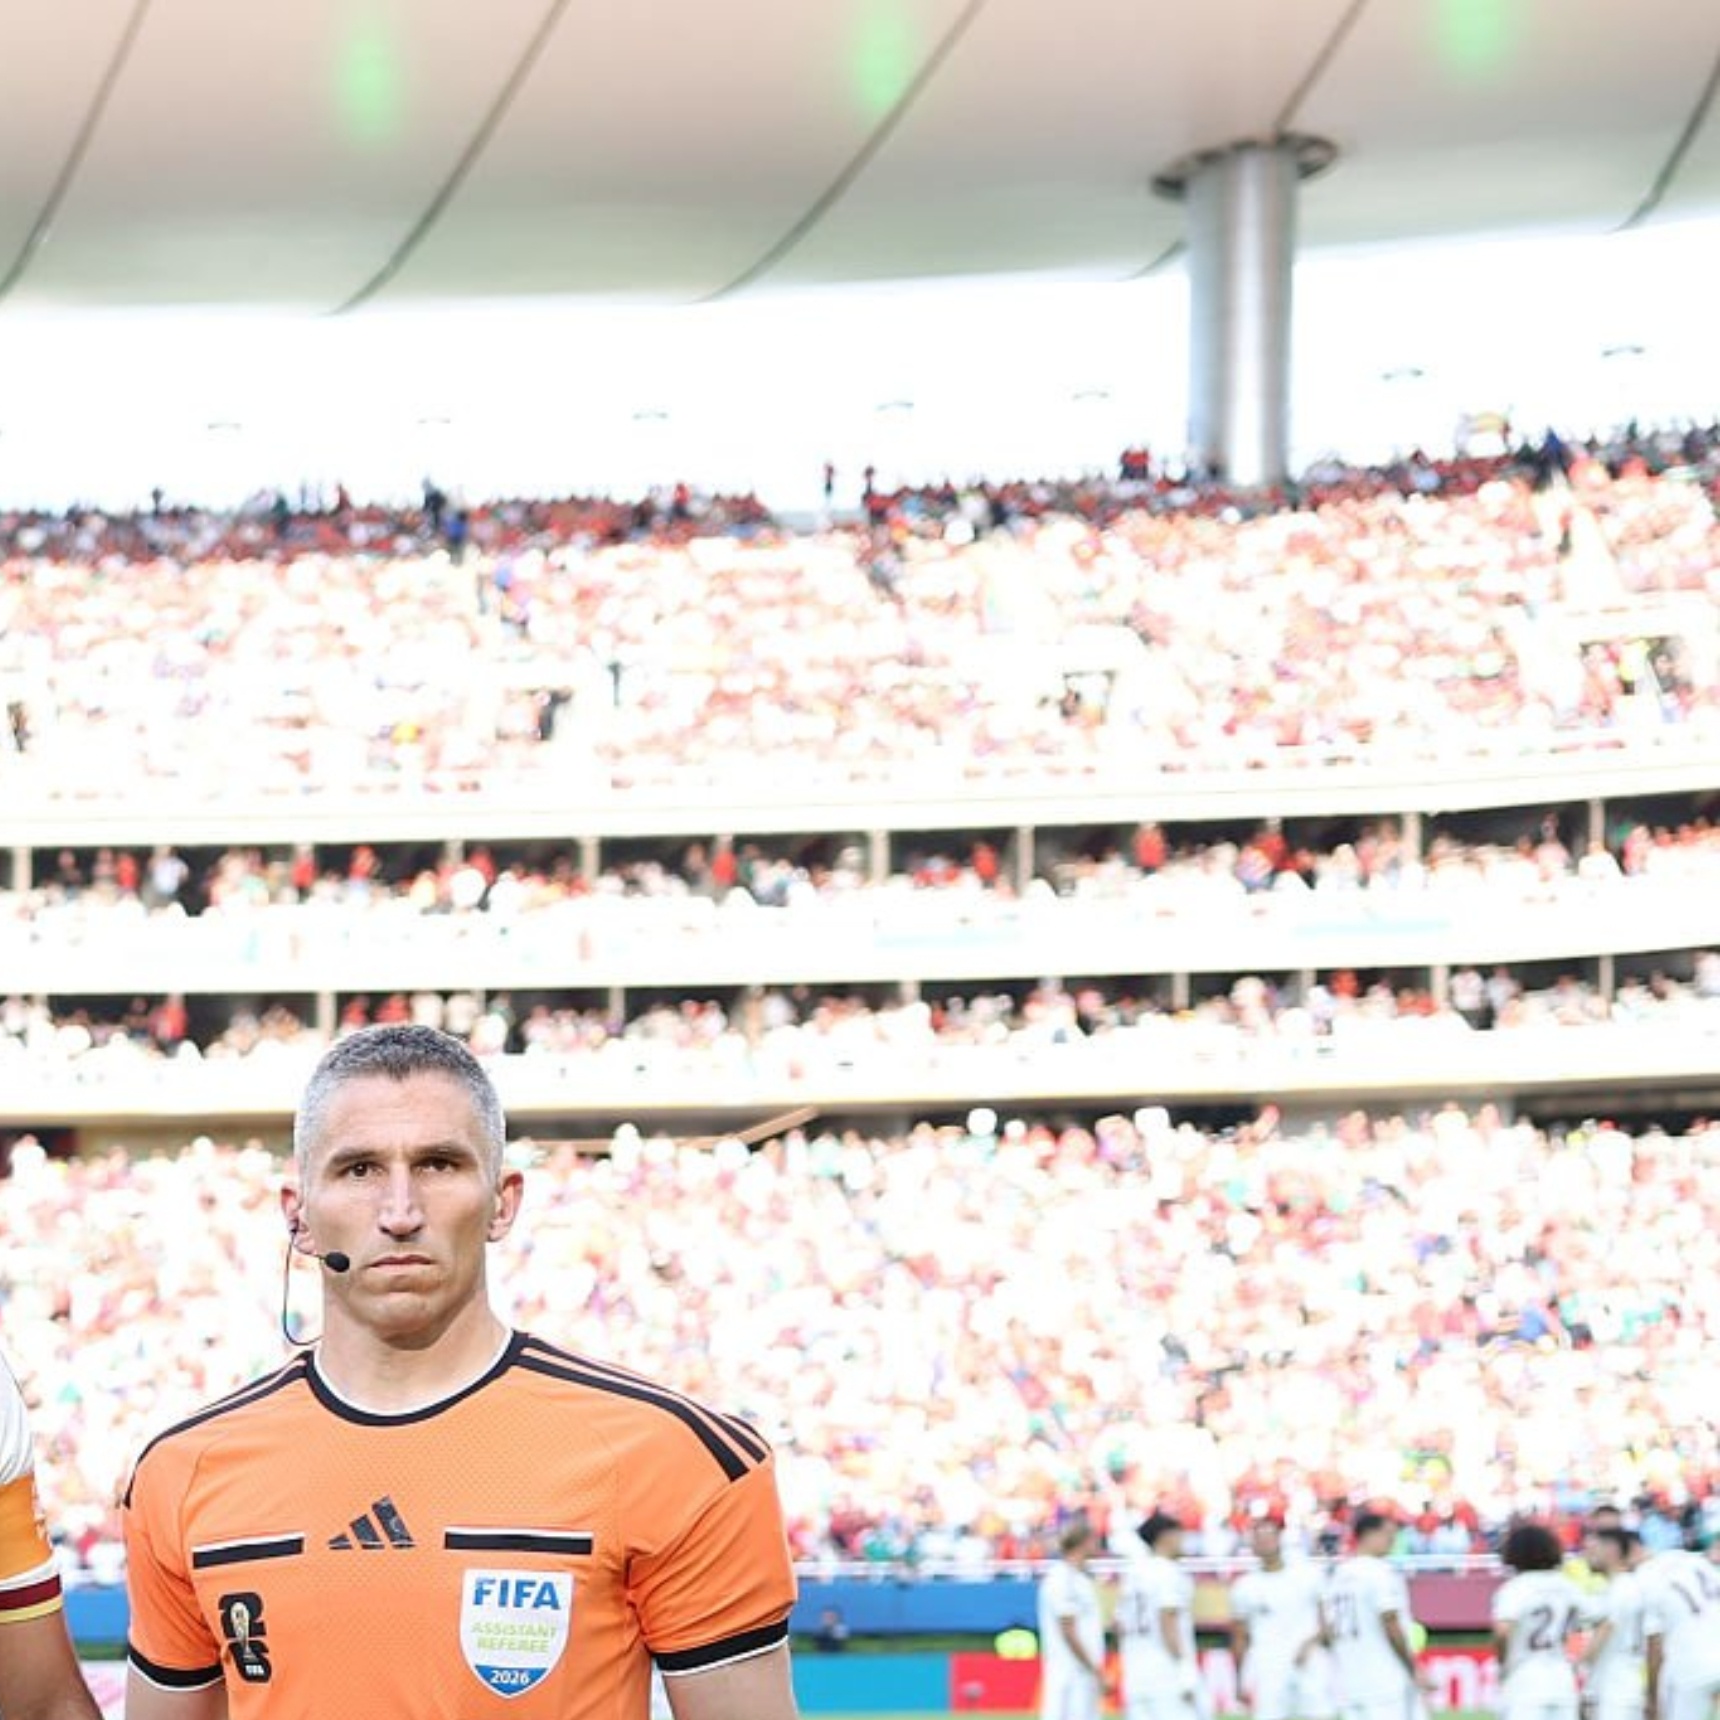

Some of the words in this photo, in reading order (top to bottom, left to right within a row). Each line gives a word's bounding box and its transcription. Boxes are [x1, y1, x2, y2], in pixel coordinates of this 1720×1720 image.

[473, 1577, 561, 1610] FIFA
[470, 1621, 557, 1638] ASSISTANT
[476, 1636, 550, 1653] REFEREE
[490, 1669, 530, 1685] 2026
